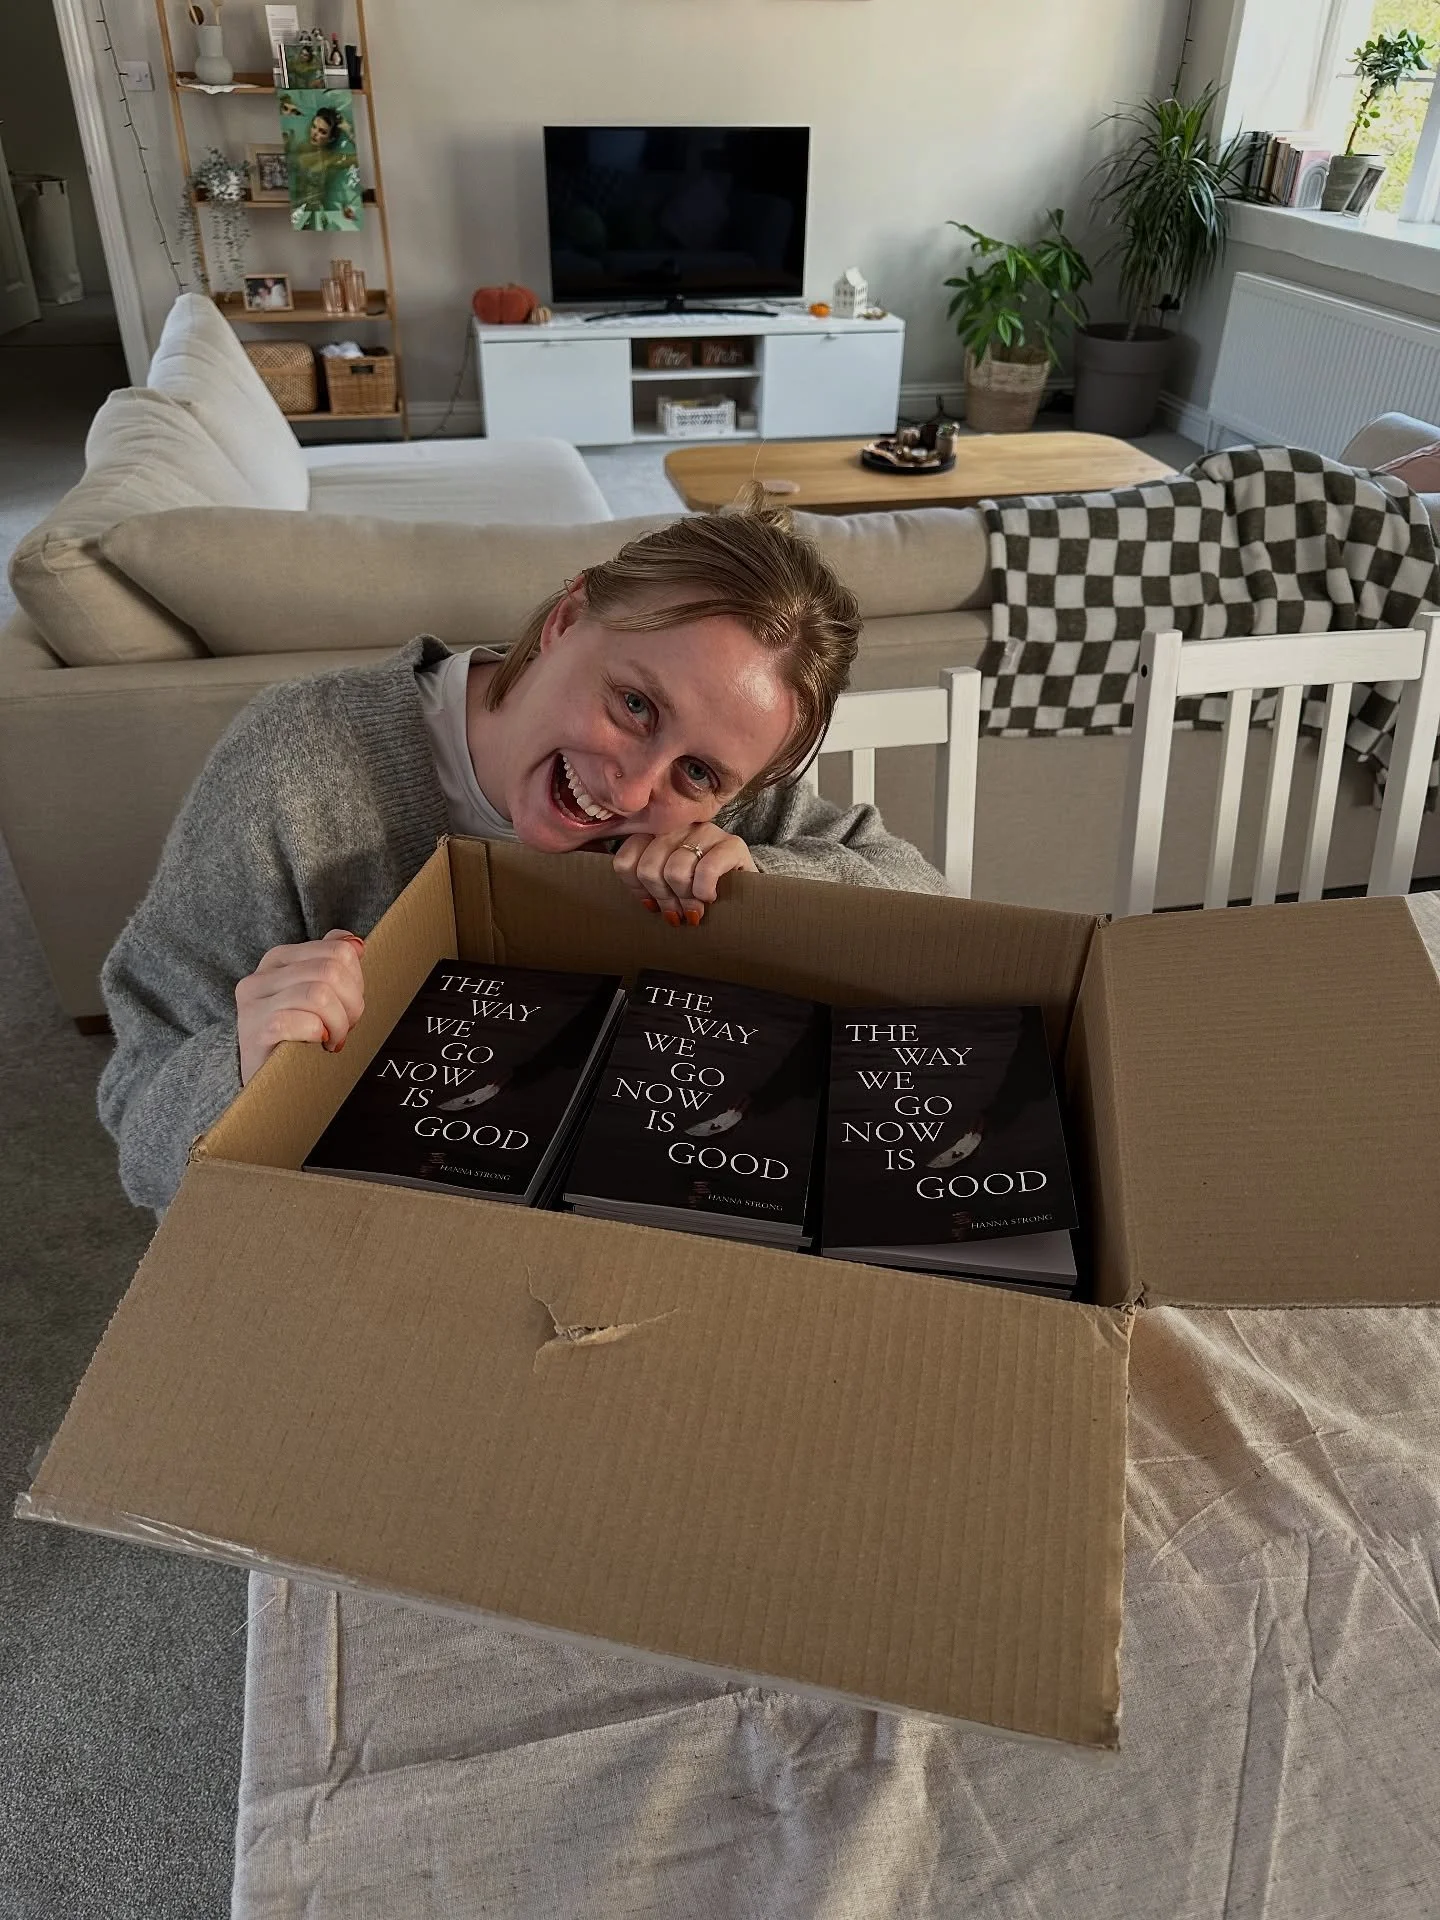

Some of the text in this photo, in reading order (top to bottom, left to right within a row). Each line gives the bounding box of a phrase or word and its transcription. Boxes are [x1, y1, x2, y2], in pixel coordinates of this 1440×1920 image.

[439, 975, 505, 997] THE
[470, 999, 541, 1021] WAY
[645, 986, 713, 1013] THE
[426, 1016, 475, 1038] WE
[684, 1014, 759, 1045] WAY
[845, 1024, 918, 1042] THE
[441, 1043, 494, 1064] GO
[644, 1031, 696, 1057] WE
[893, 1047, 973, 1066] WAY
[377, 1059, 476, 1087] NOW
[671, 1063, 725, 1087] GO
[856, 1070, 915, 1090] WE
[400, 1086, 434, 1108] IS
[611, 1077, 713, 1110] NOW
[894, 1095, 953, 1116] GO
[644, 1109, 676, 1133] IS
[842, 1121, 944, 1143] NOW
[414, 1116, 529, 1150] GOOD
[668, 1142, 789, 1180] GOOD
[884, 1148, 916, 1171] IS
[440, 1164, 510, 1181] HANNA STRONG
[916, 1170, 1047, 1200] GOOD
[708, 1194, 783, 1211] HANNA STRONG
[971, 1214, 1053, 1229] HANNA STRONG
